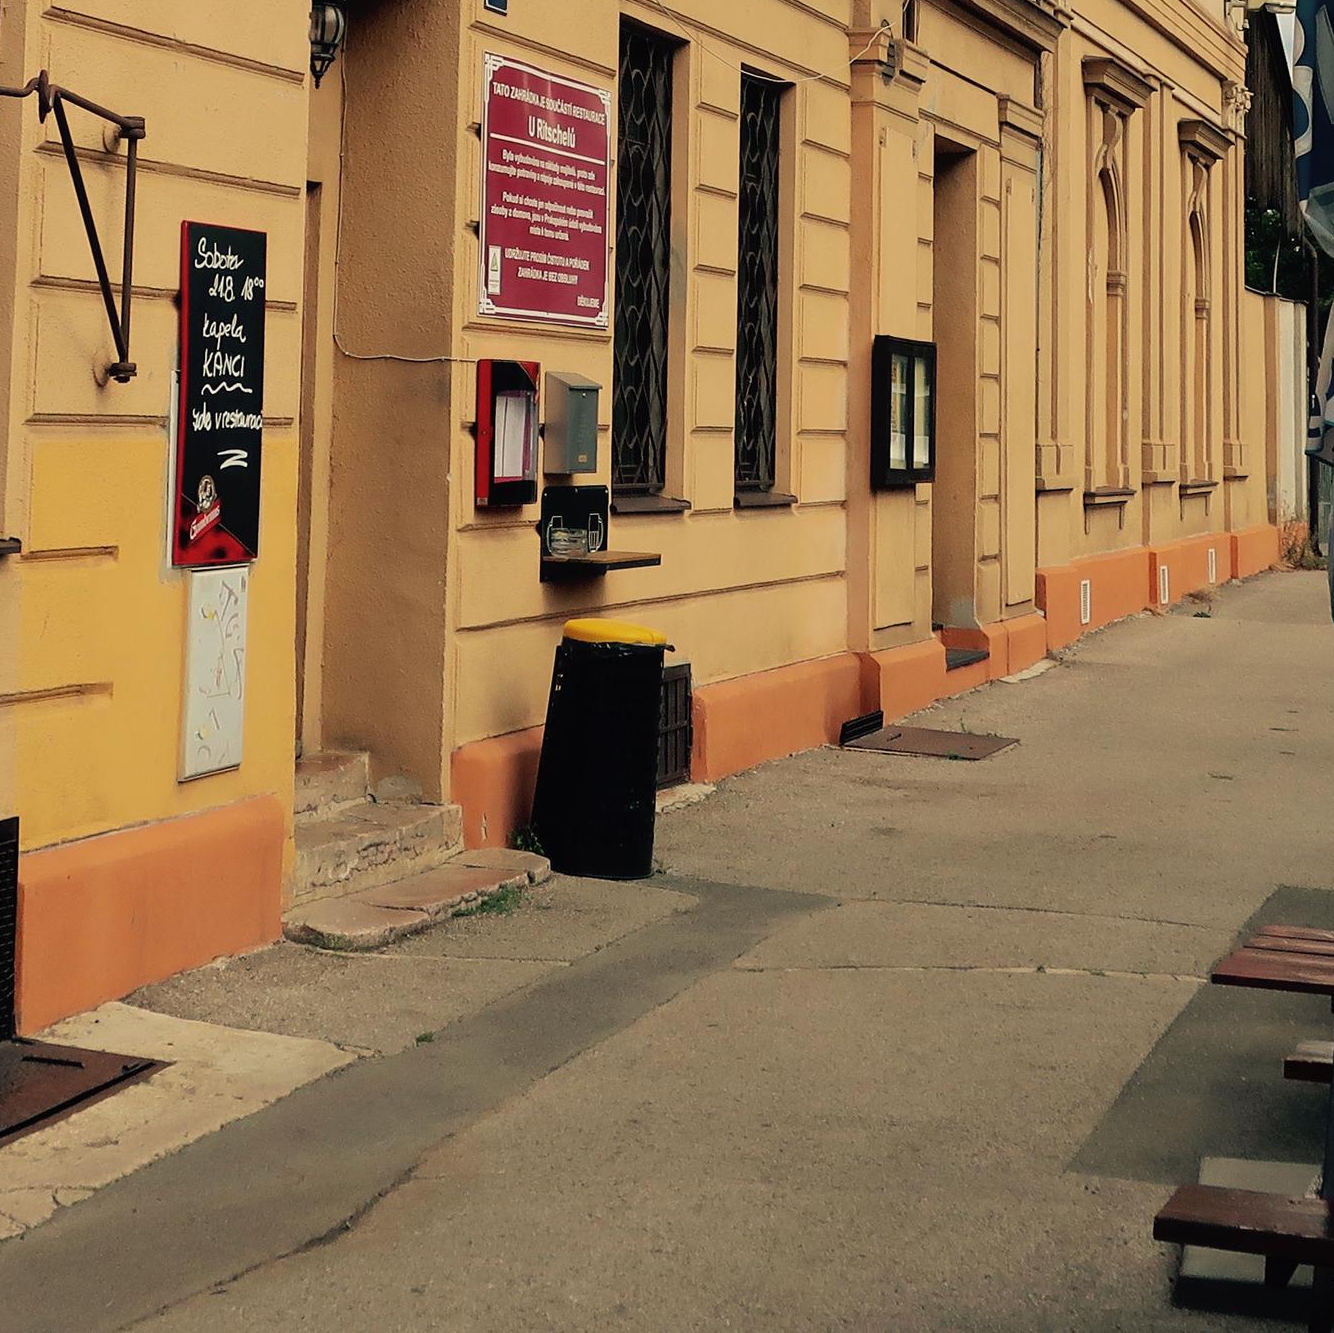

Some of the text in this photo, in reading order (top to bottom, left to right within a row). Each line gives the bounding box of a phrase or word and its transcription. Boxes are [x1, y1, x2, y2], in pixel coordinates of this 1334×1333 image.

[528, 115, 535, 137] U
[195, 237, 244, 270] Sobota
[202, 312, 247, 351] kapela
[203, 348, 245, 378] KANCI
